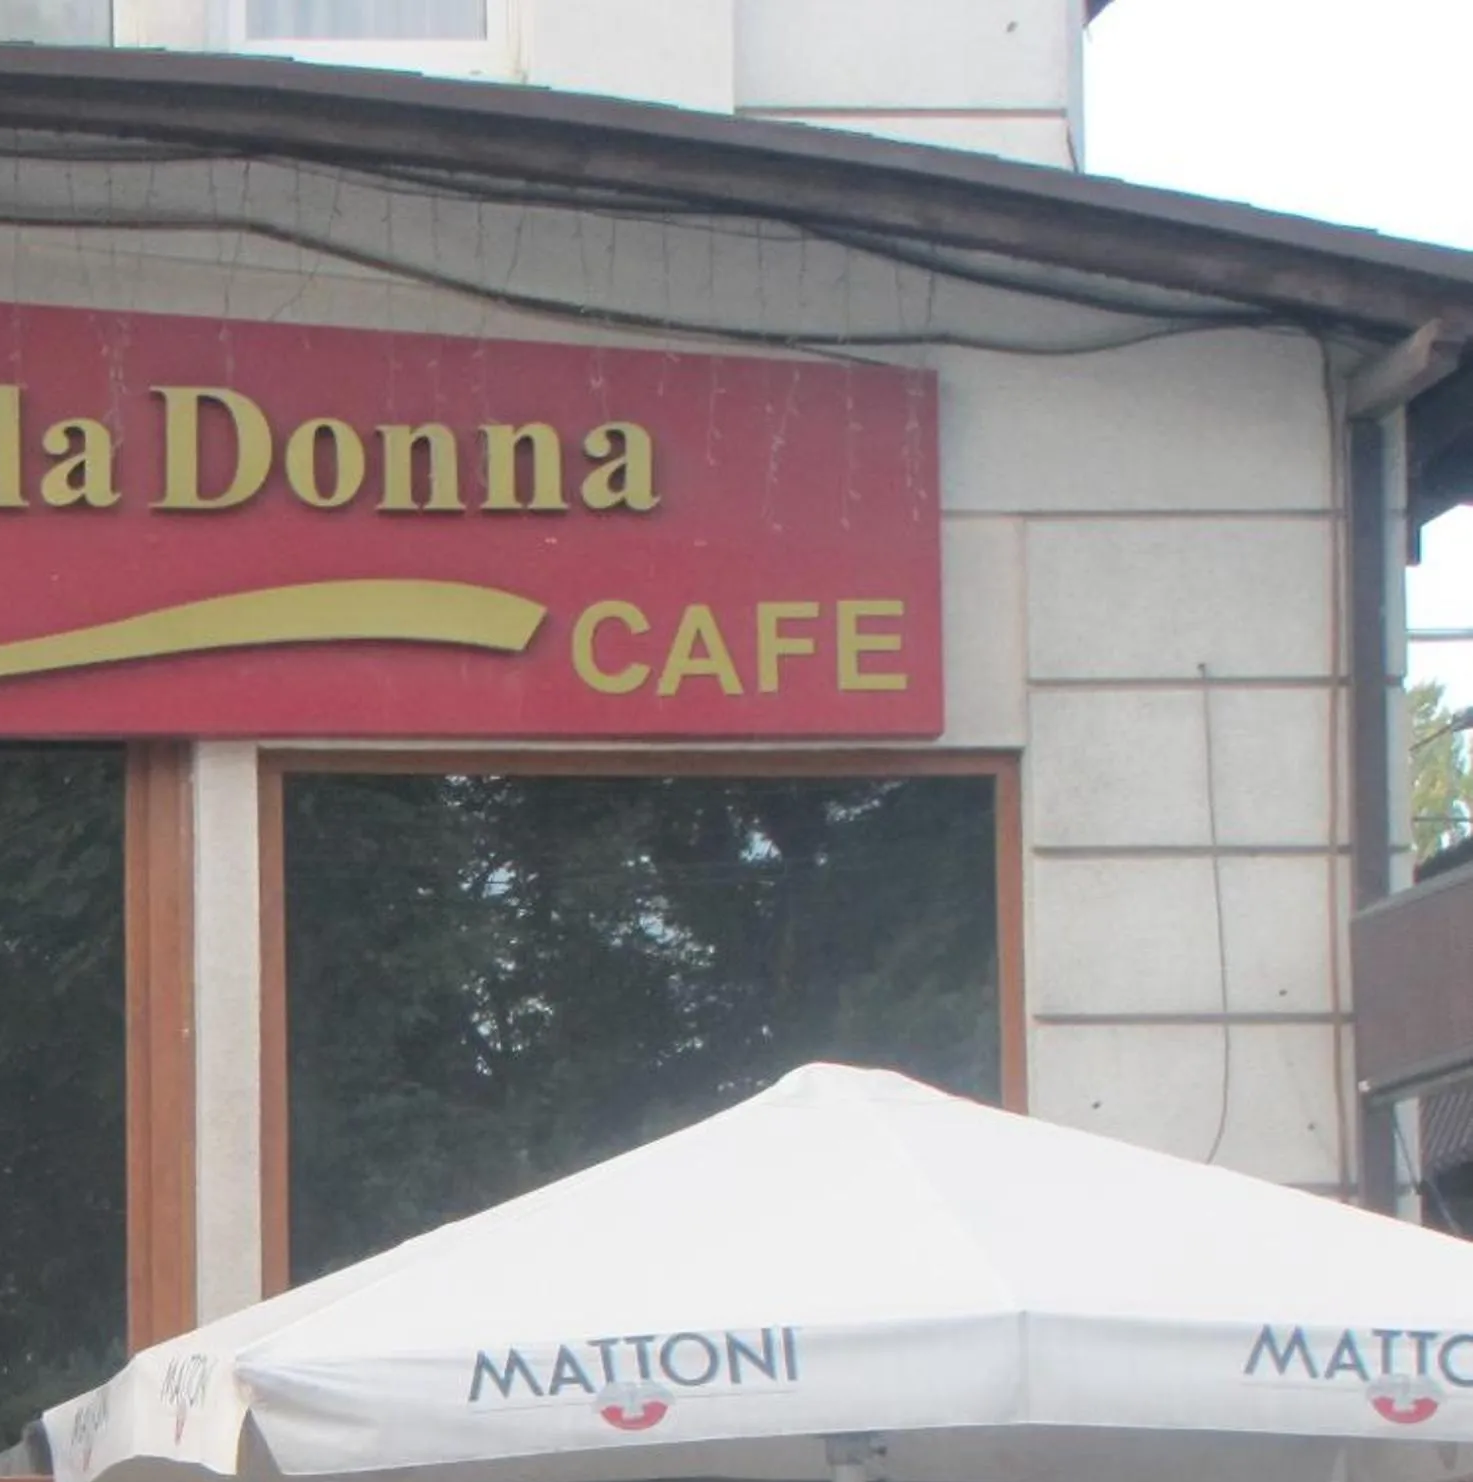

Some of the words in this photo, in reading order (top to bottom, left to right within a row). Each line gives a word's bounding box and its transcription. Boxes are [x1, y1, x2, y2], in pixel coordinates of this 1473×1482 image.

[151, 385, 663, 516] Donna
[569, 598, 909, 697] CAFE
[467, 1326, 799, 1403] MATTONI
